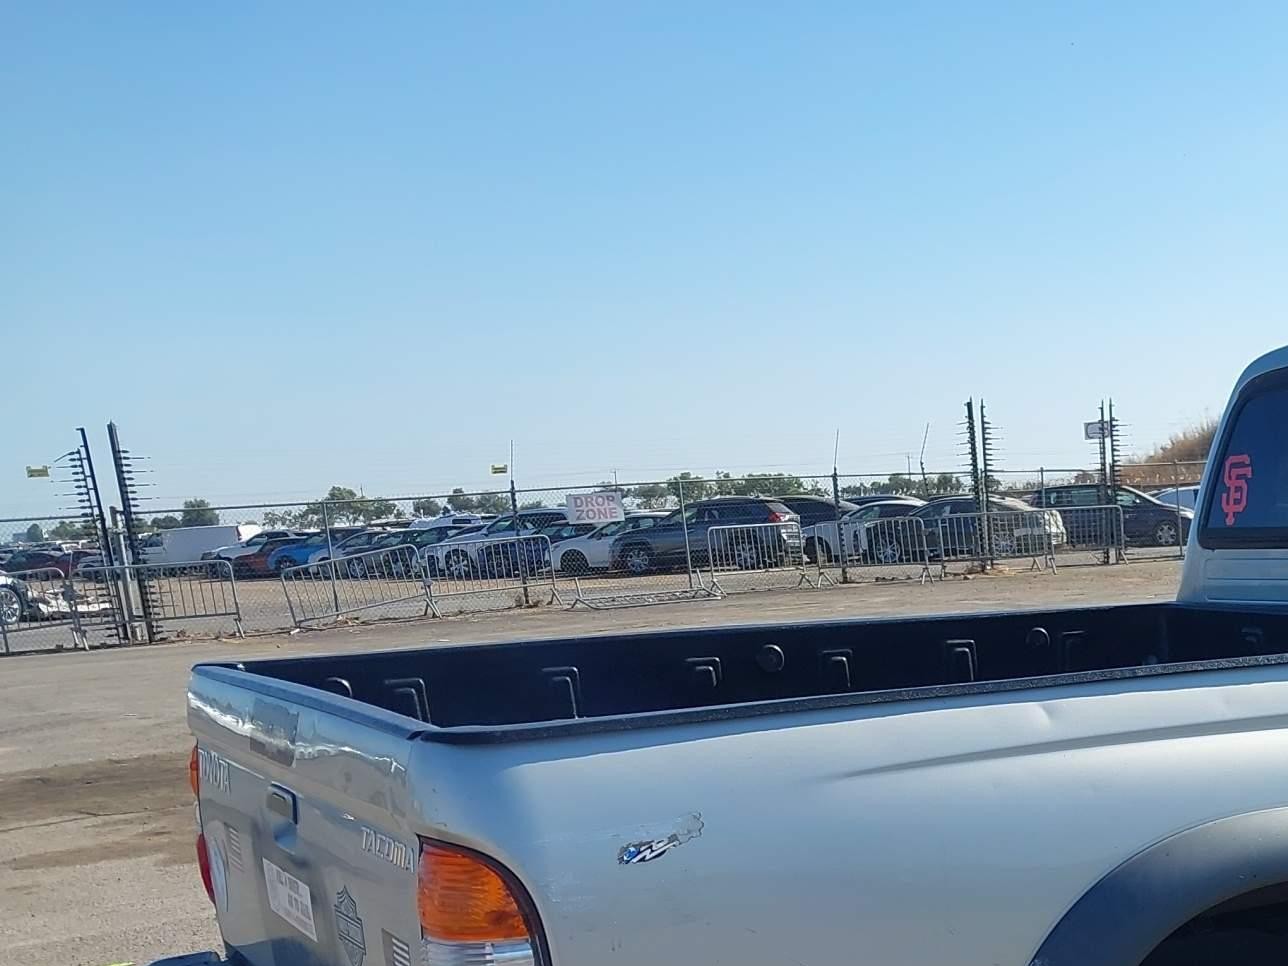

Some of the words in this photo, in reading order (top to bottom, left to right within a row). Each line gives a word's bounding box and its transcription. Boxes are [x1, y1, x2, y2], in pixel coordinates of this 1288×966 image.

[573, 495, 615, 508] DROP
[575, 507, 618, 521] ZONE
[360, 825, 414, 873] TACOMA
